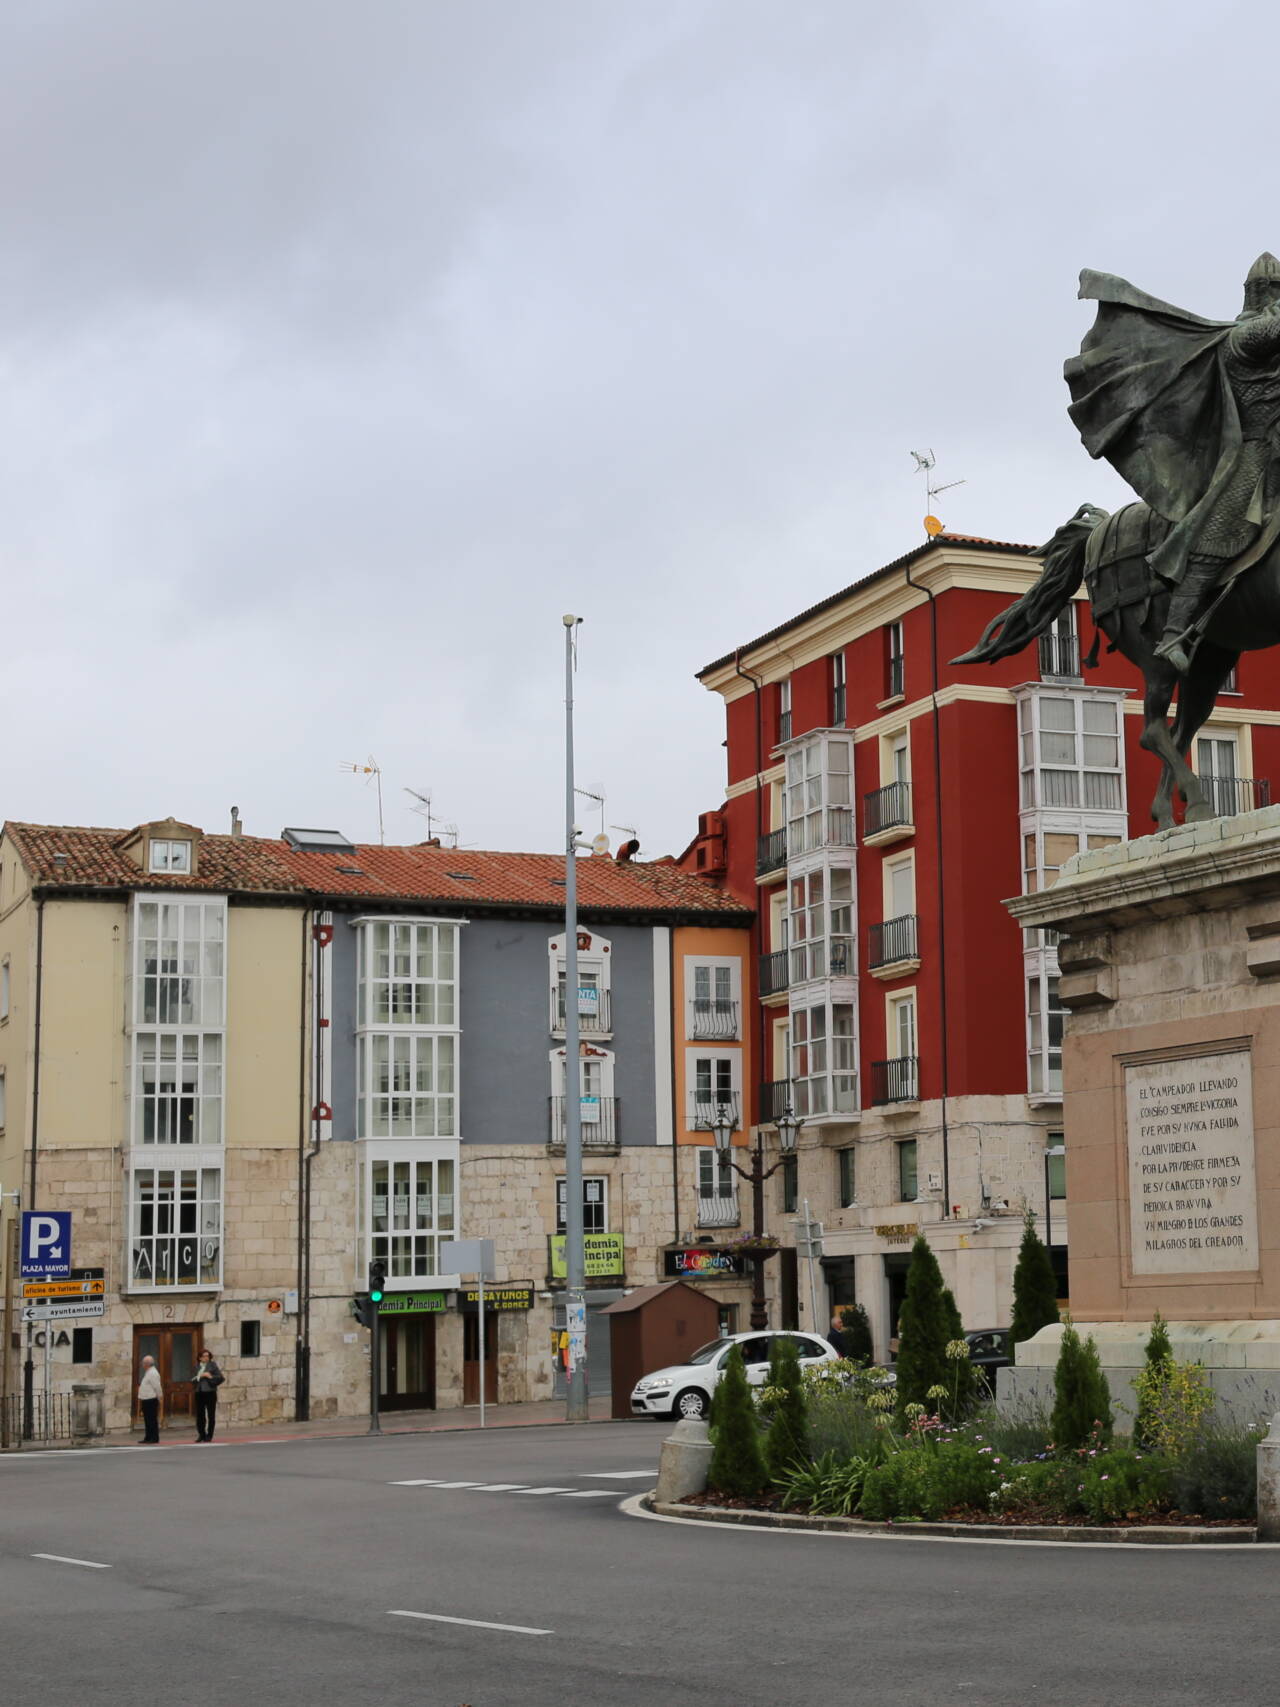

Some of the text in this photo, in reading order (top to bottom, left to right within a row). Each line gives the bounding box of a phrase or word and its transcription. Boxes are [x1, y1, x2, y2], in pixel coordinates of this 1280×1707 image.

[577, 989, 597, 1000] NTA
[1139, 1089, 1148, 1099] EL
[1199, 1077, 1238, 1092] LLEVANDO
[1140, 1106, 1169, 1118] CONSIGO
[1170, 1101, 1199, 1115] SIEMPRE
[1157, 1124, 1171, 1135] POR
[1210, 1116, 1239, 1130] FALLIDA
[1141, 1141, 1197, 1156] CLARIVIDENCIA
[1142, 1163, 1157, 1175] POR
[1158, 1163, 1168, 1174] LA
[1143, 1183, 1152, 1193] DE
[1206, 1179, 1211, 1188] Y
[1212, 1177, 1228, 1188] POR
[1194, 1217, 1208, 1229] LOS
[1210, 1214, 1244, 1227] GRANDES
[29, 1216, 60, 1259] P
[584, 1238, 618, 1249] demia
[1145, 1235, 1244, 1251] MILAGROS DEL CREADOR
[584, 1248, 621, 1261] incipal
[22, 1264, 69, 1273] PLAZA MAYOR
[25, 1286, 46, 1295] oficina
[467, 1291, 529, 1302] DESAYUNOS
[407, 1296, 442, 1310] Principal
[50, 1305, 102, 1316] ayuntamiento
[164, 1305, 175, 1318] 2
